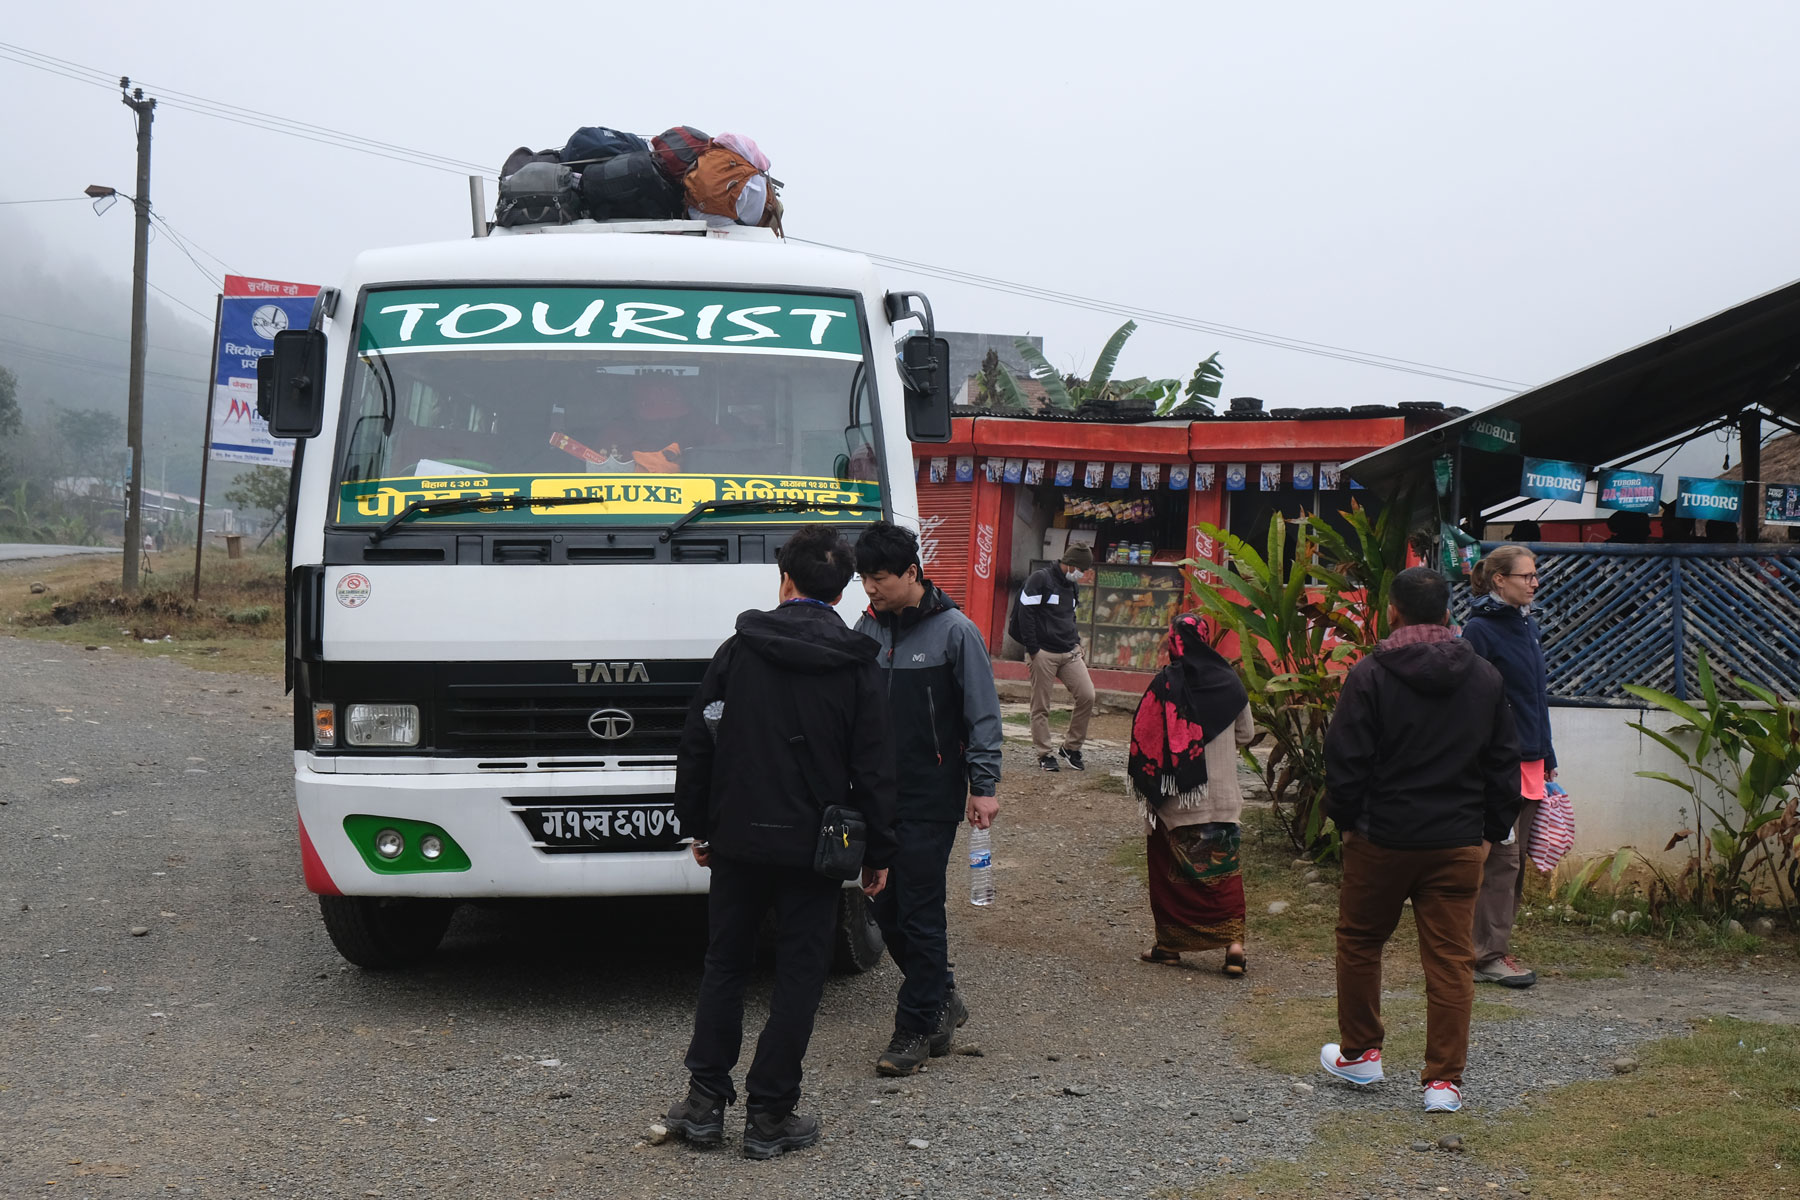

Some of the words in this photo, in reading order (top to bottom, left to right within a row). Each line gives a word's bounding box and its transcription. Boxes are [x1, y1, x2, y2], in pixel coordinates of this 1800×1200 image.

[381, 299, 847, 345] TOURIST
[1527, 473, 1582, 491] TUBORG
[1612, 478, 1642, 487] TUBORG
[563, 484, 682, 504] DELUXE
[1681, 492, 1739, 511] TUBORG
[974, 522, 993, 579] Coca-Cola
[572, 662, 650, 683] TATA
